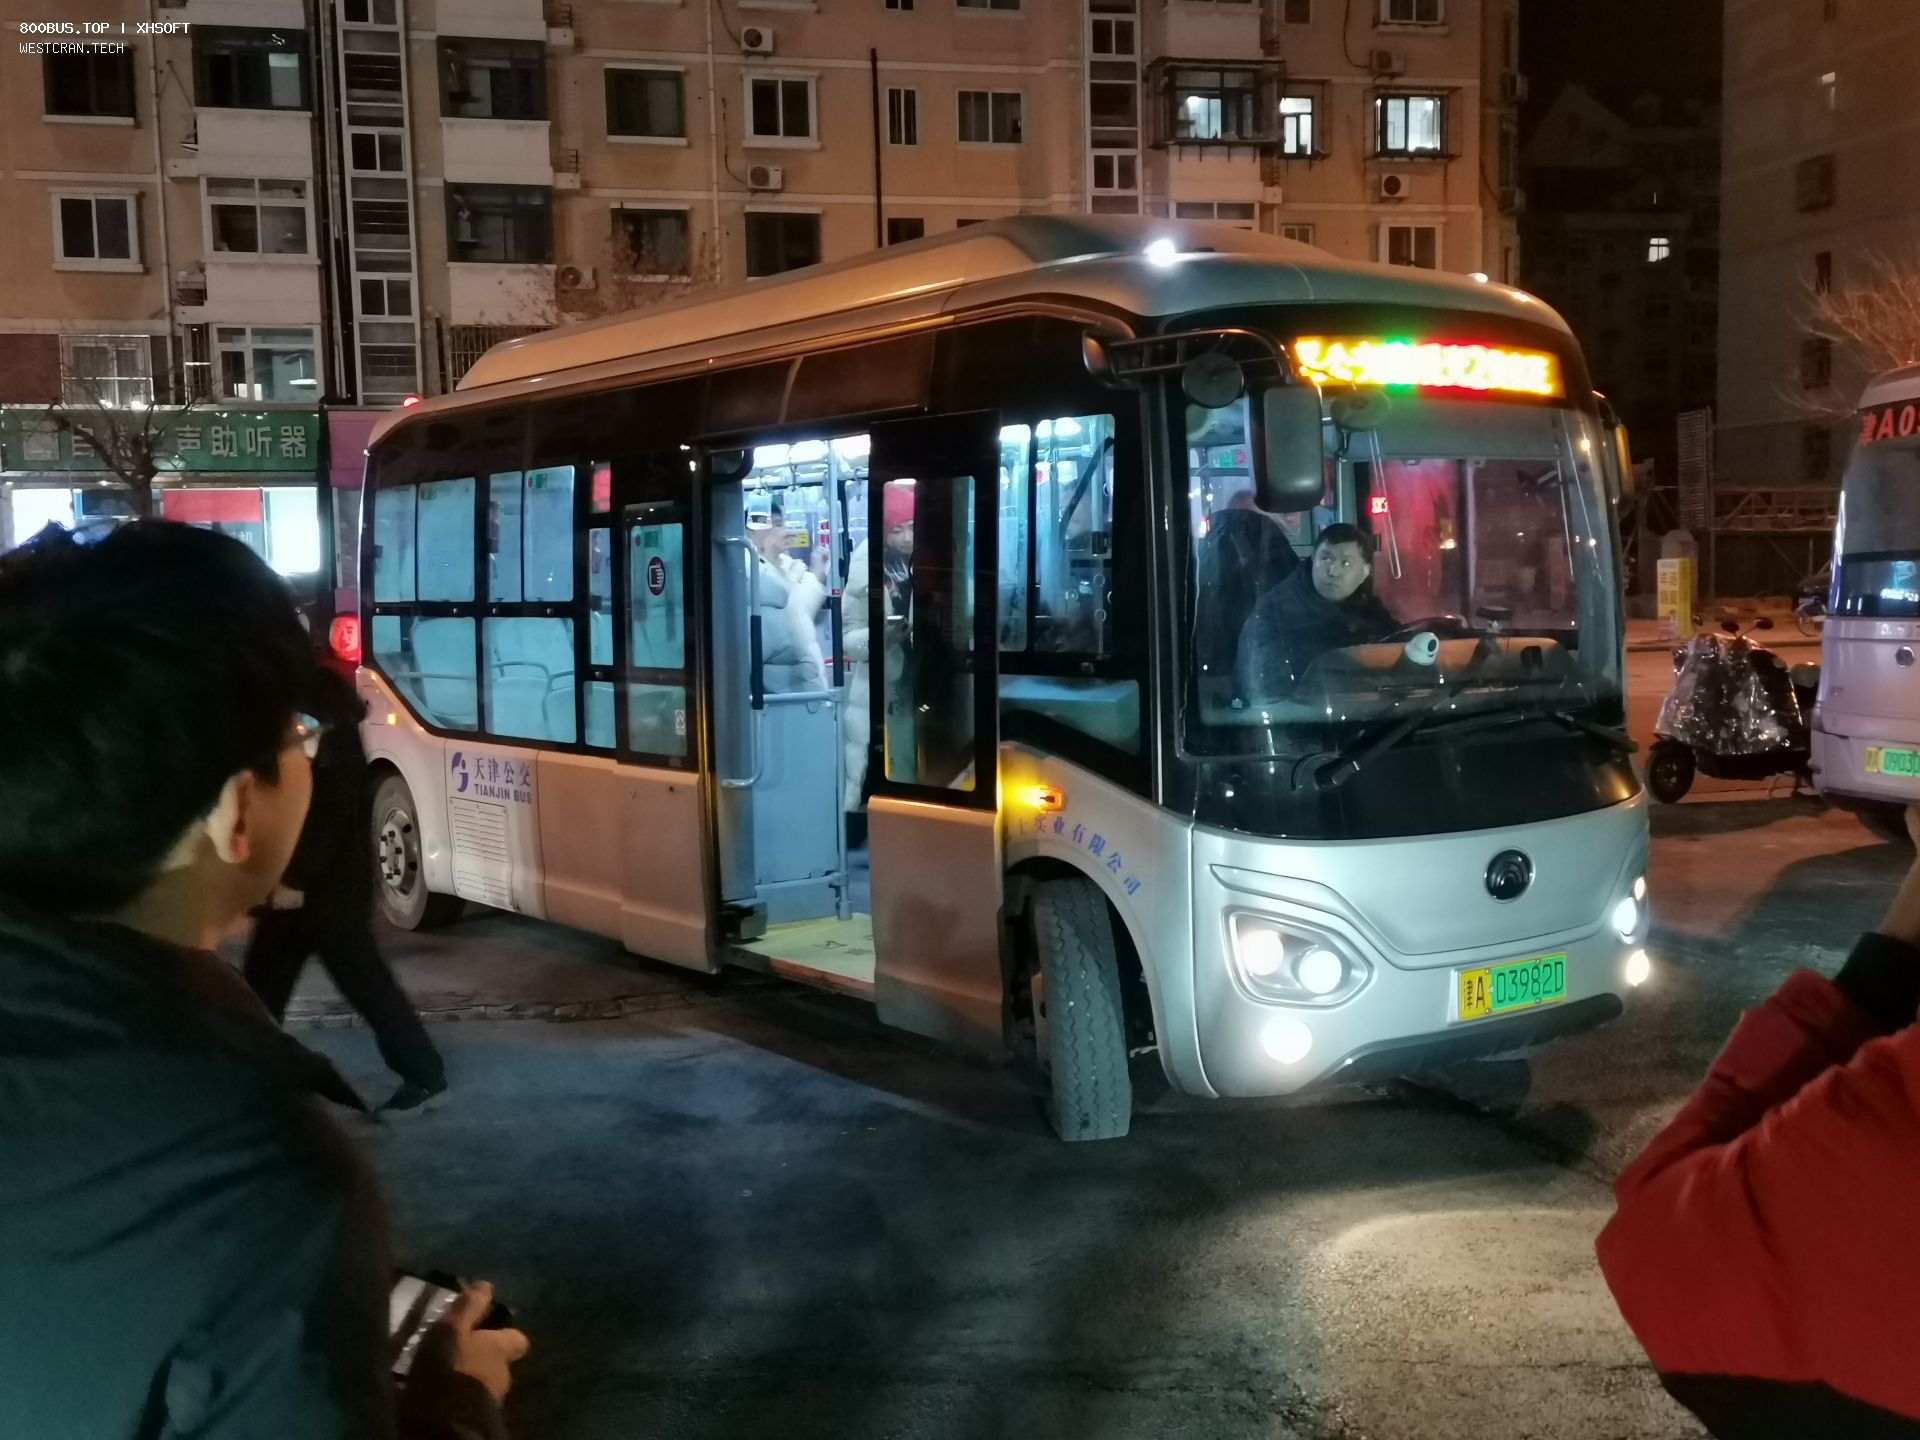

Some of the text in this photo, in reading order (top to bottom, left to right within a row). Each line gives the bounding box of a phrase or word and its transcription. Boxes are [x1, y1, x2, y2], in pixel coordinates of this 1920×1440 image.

[1858, 404, 1920, 447] 津A0
[473, 757, 530, 787] 天津公交
[474, 783, 532, 804] TIANJIN BUS
